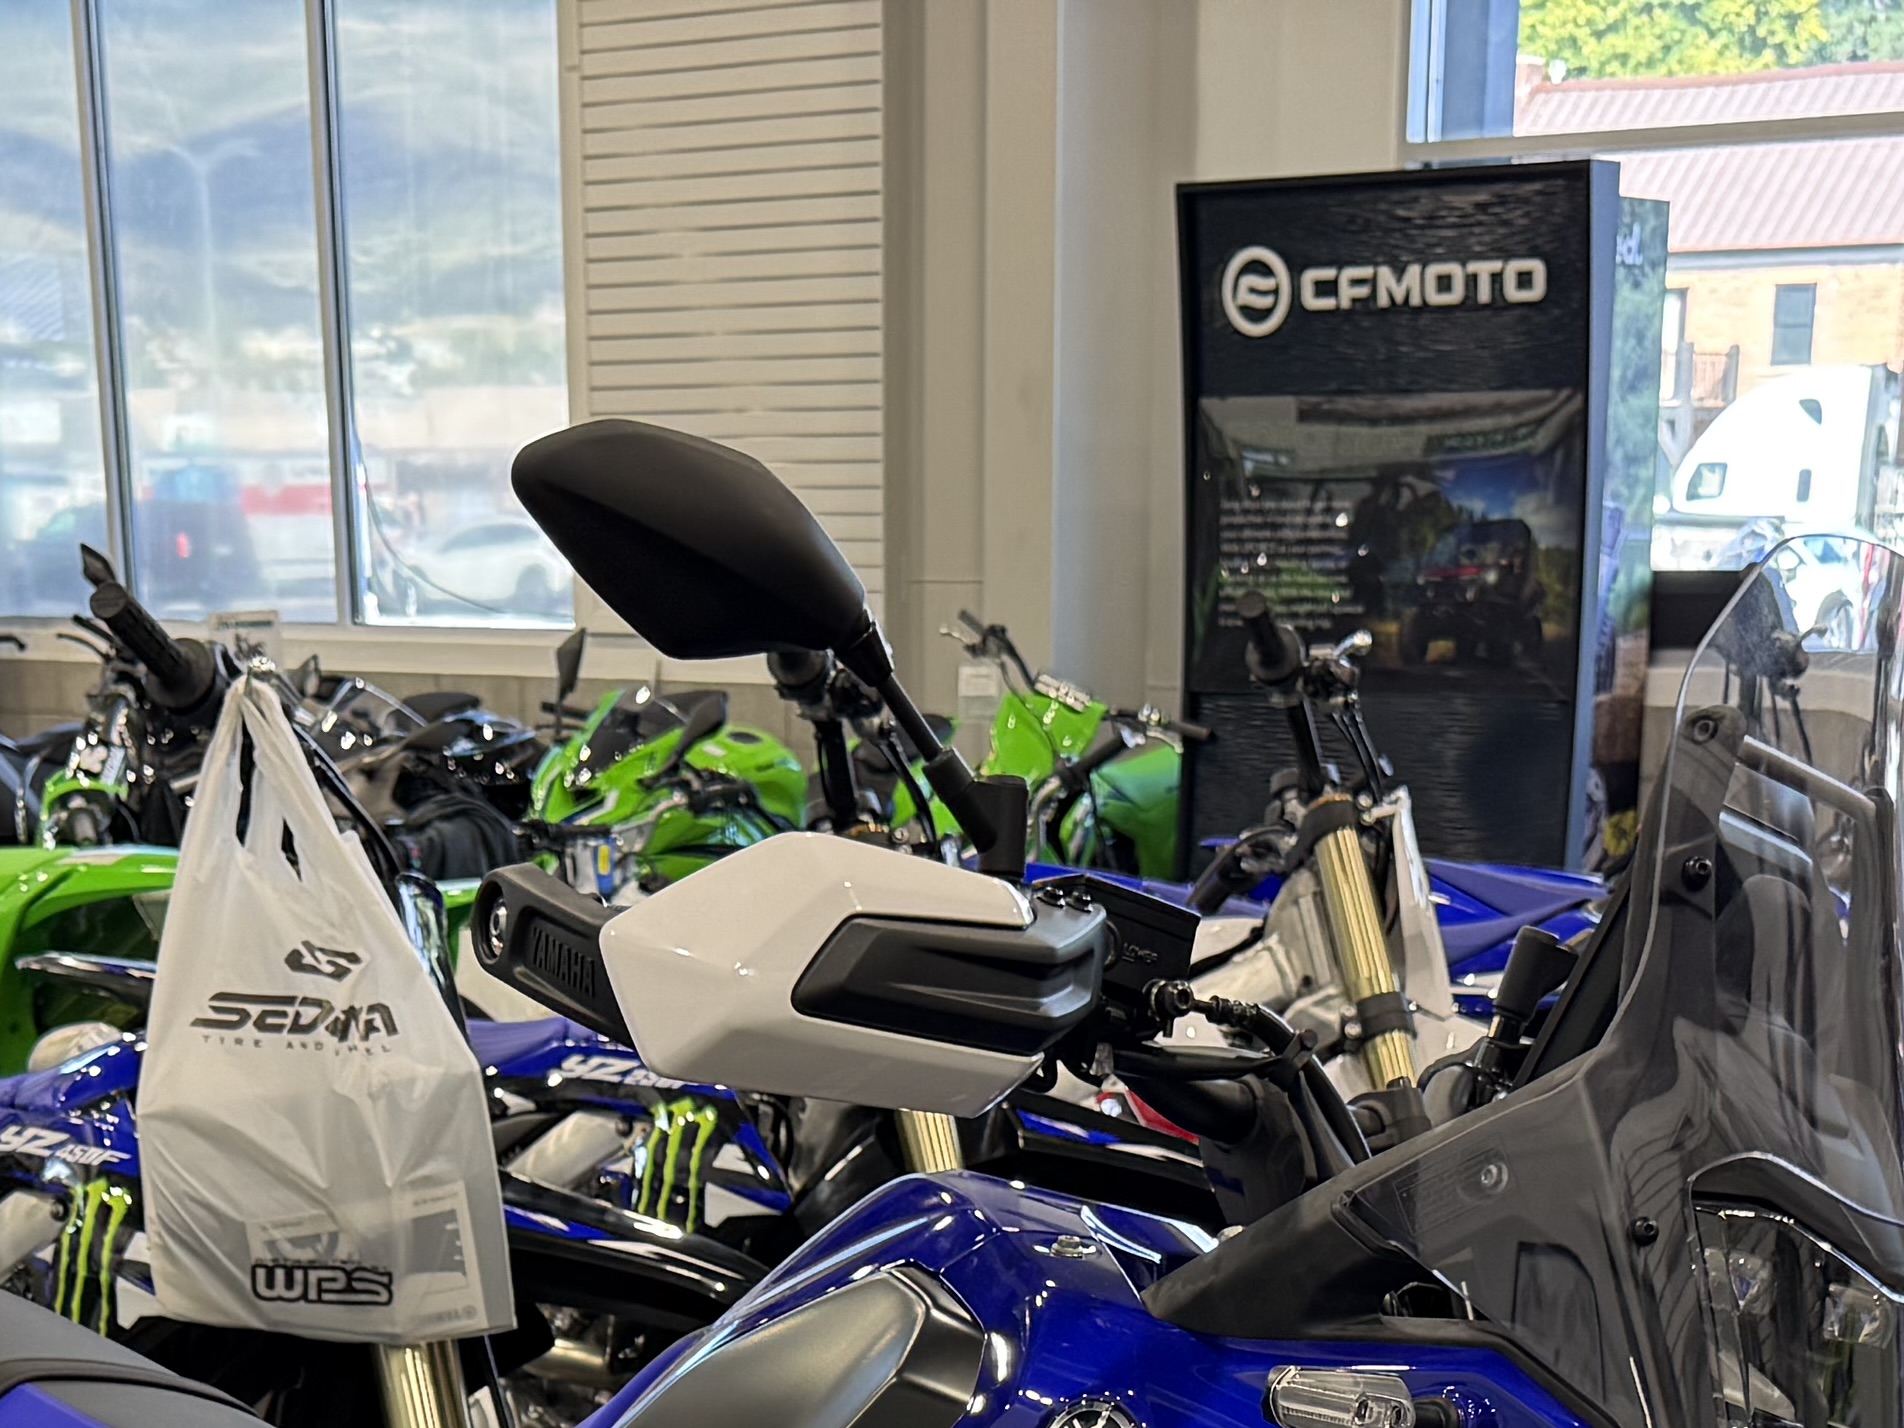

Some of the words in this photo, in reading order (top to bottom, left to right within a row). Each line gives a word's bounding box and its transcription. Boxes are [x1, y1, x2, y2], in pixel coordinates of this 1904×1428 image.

[1300, 258, 1547, 312] CFMOTO
[529, 926, 597, 1001] YAMAHA
[202, 1034, 264, 1049] TIRE
[250, 1263, 394, 1307] WPS
